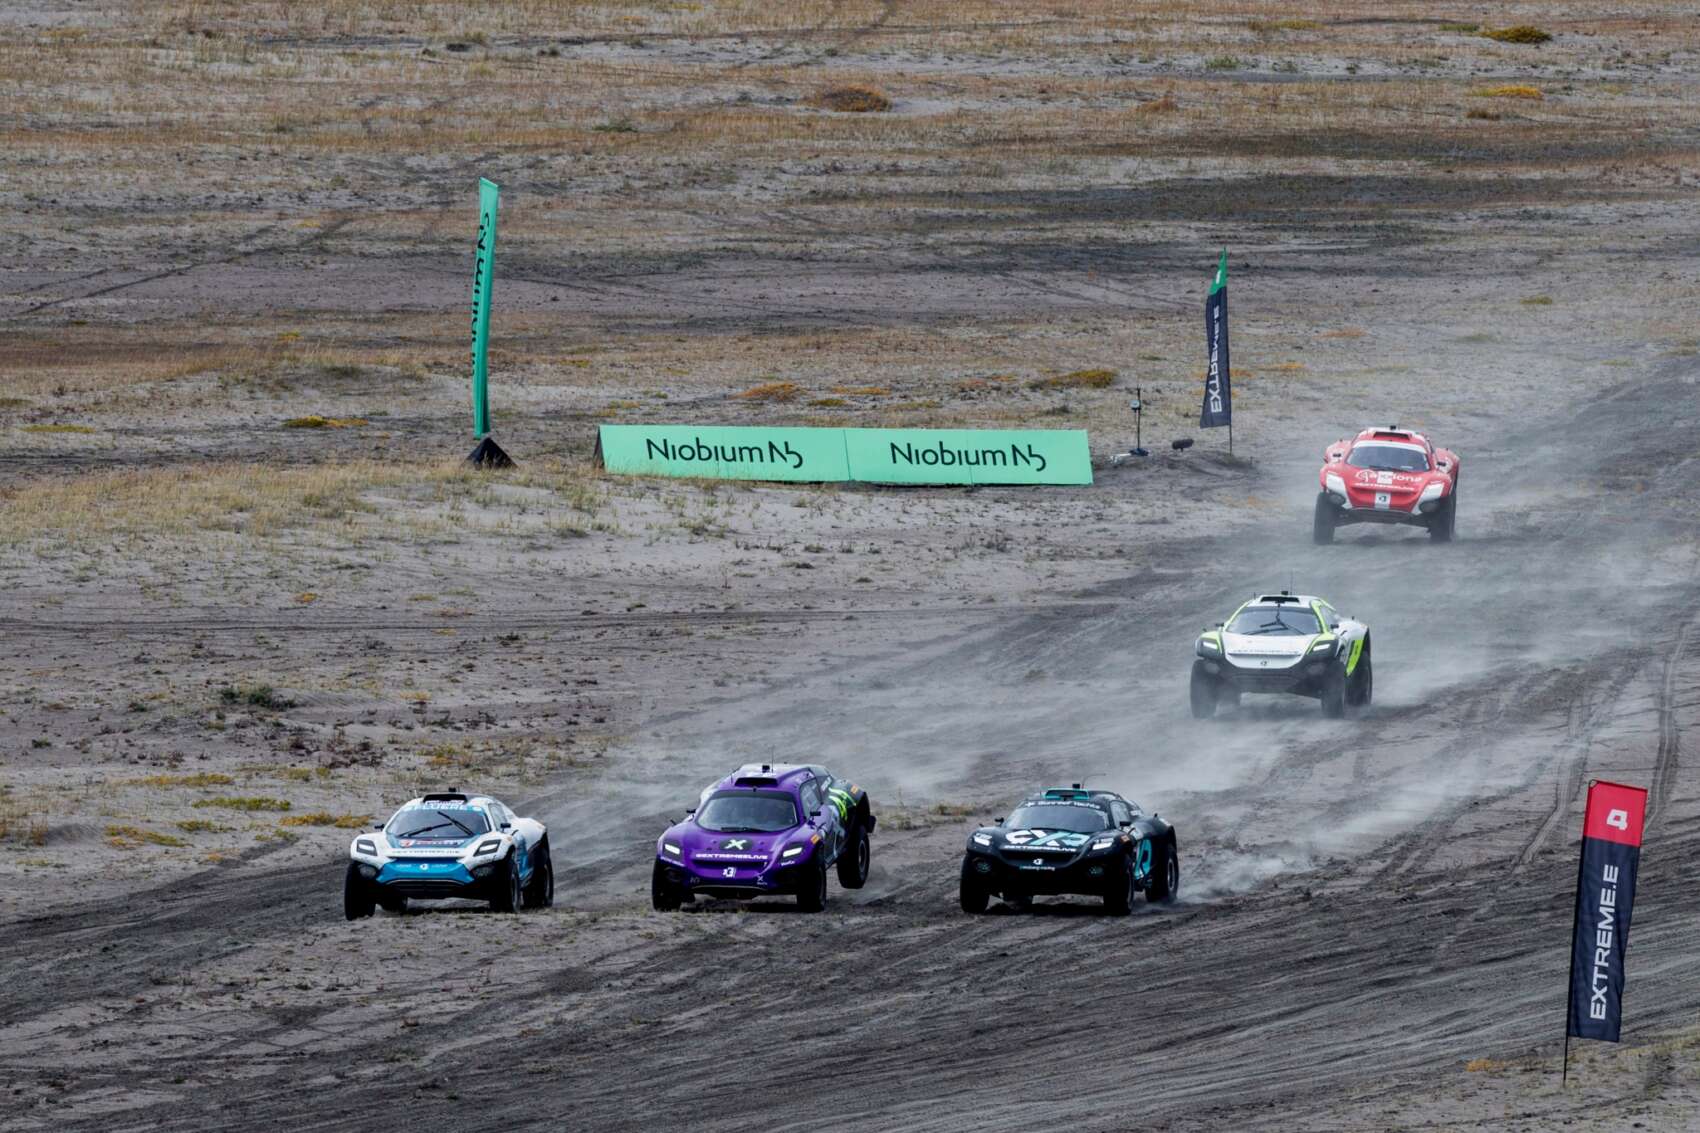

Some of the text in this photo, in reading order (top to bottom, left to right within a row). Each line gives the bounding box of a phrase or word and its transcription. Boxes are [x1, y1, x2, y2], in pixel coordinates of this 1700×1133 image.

[646, 437, 764, 463] Niobium
[890, 441, 1008, 467] Niobium
[1606, 808, 1628, 831] 4
[1589, 864, 1619, 1020] EXTREME.E
